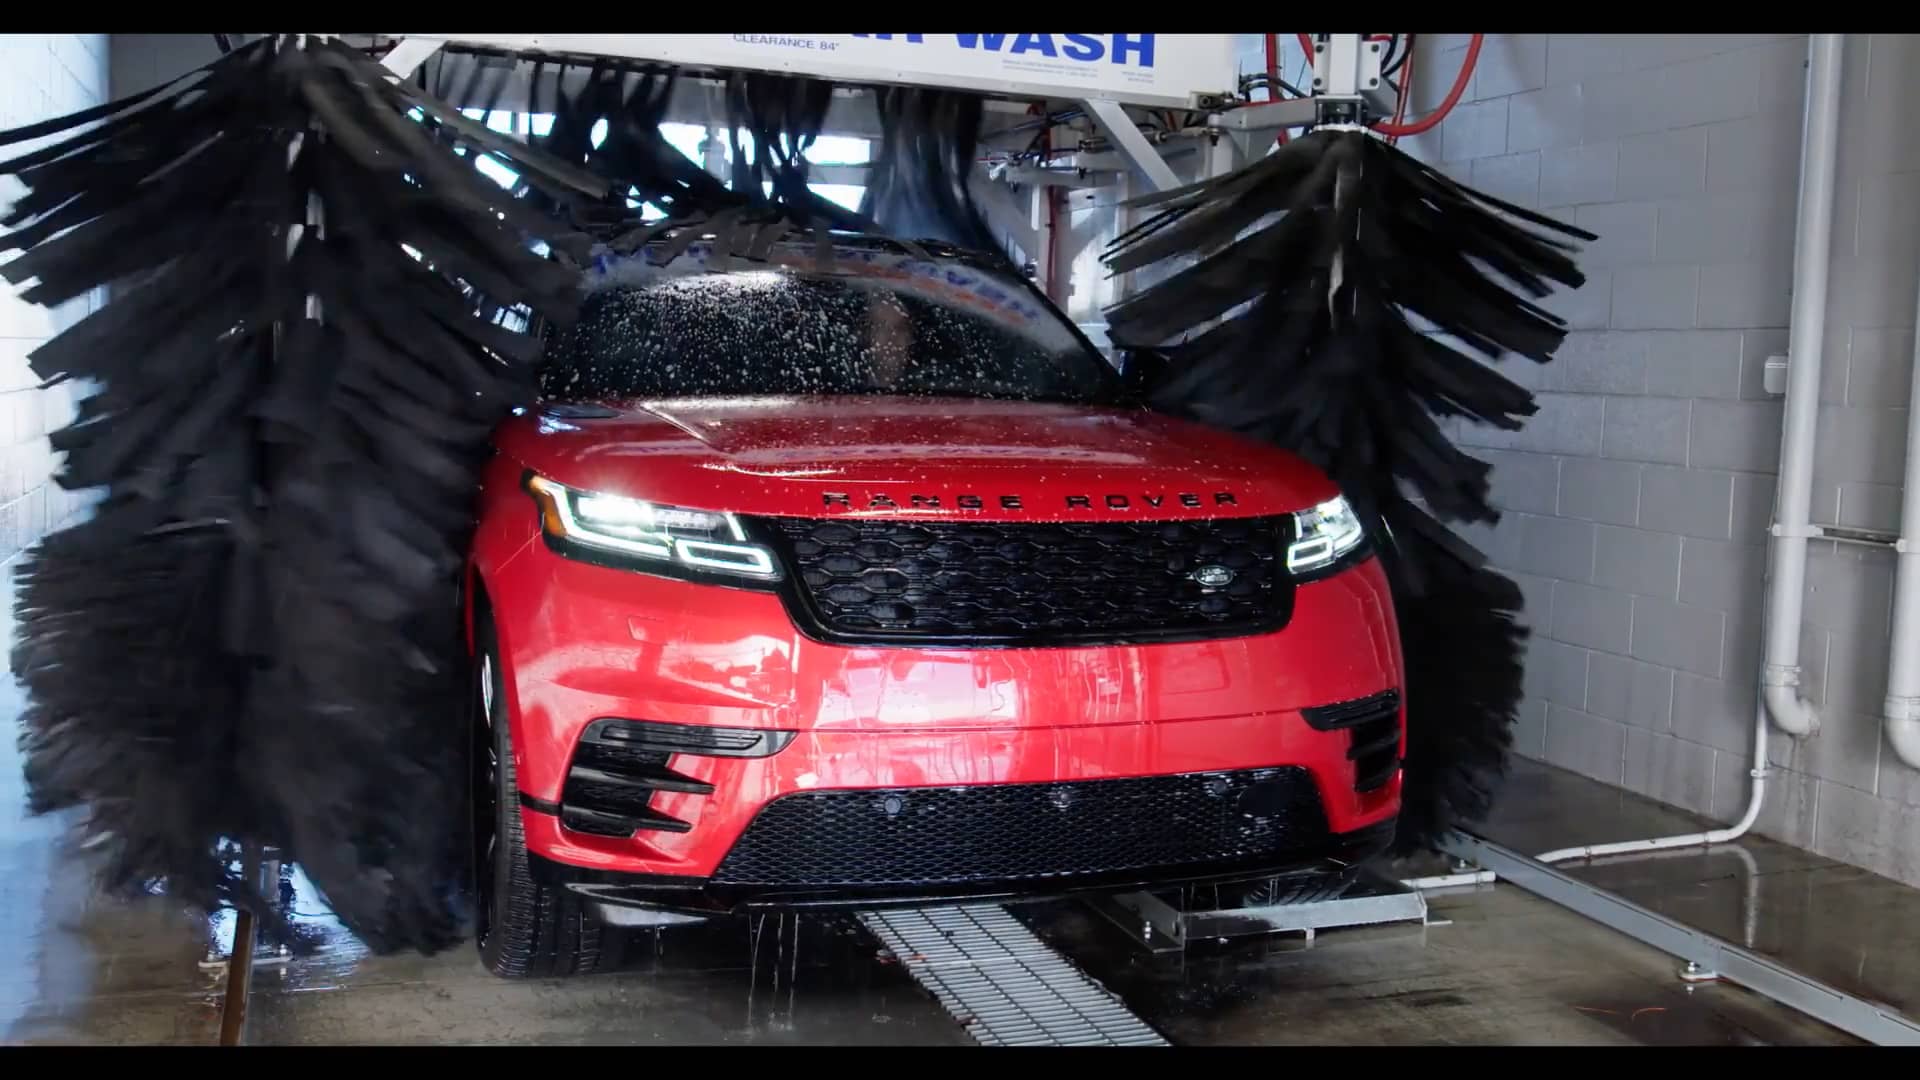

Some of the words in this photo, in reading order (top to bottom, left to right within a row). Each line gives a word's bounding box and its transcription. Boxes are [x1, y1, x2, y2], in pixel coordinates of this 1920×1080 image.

[732, 34, 816, 49] CLEARANCE
[822, 492, 1024, 509] RANGE
[1065, 492, 1238, 510] ROVER
